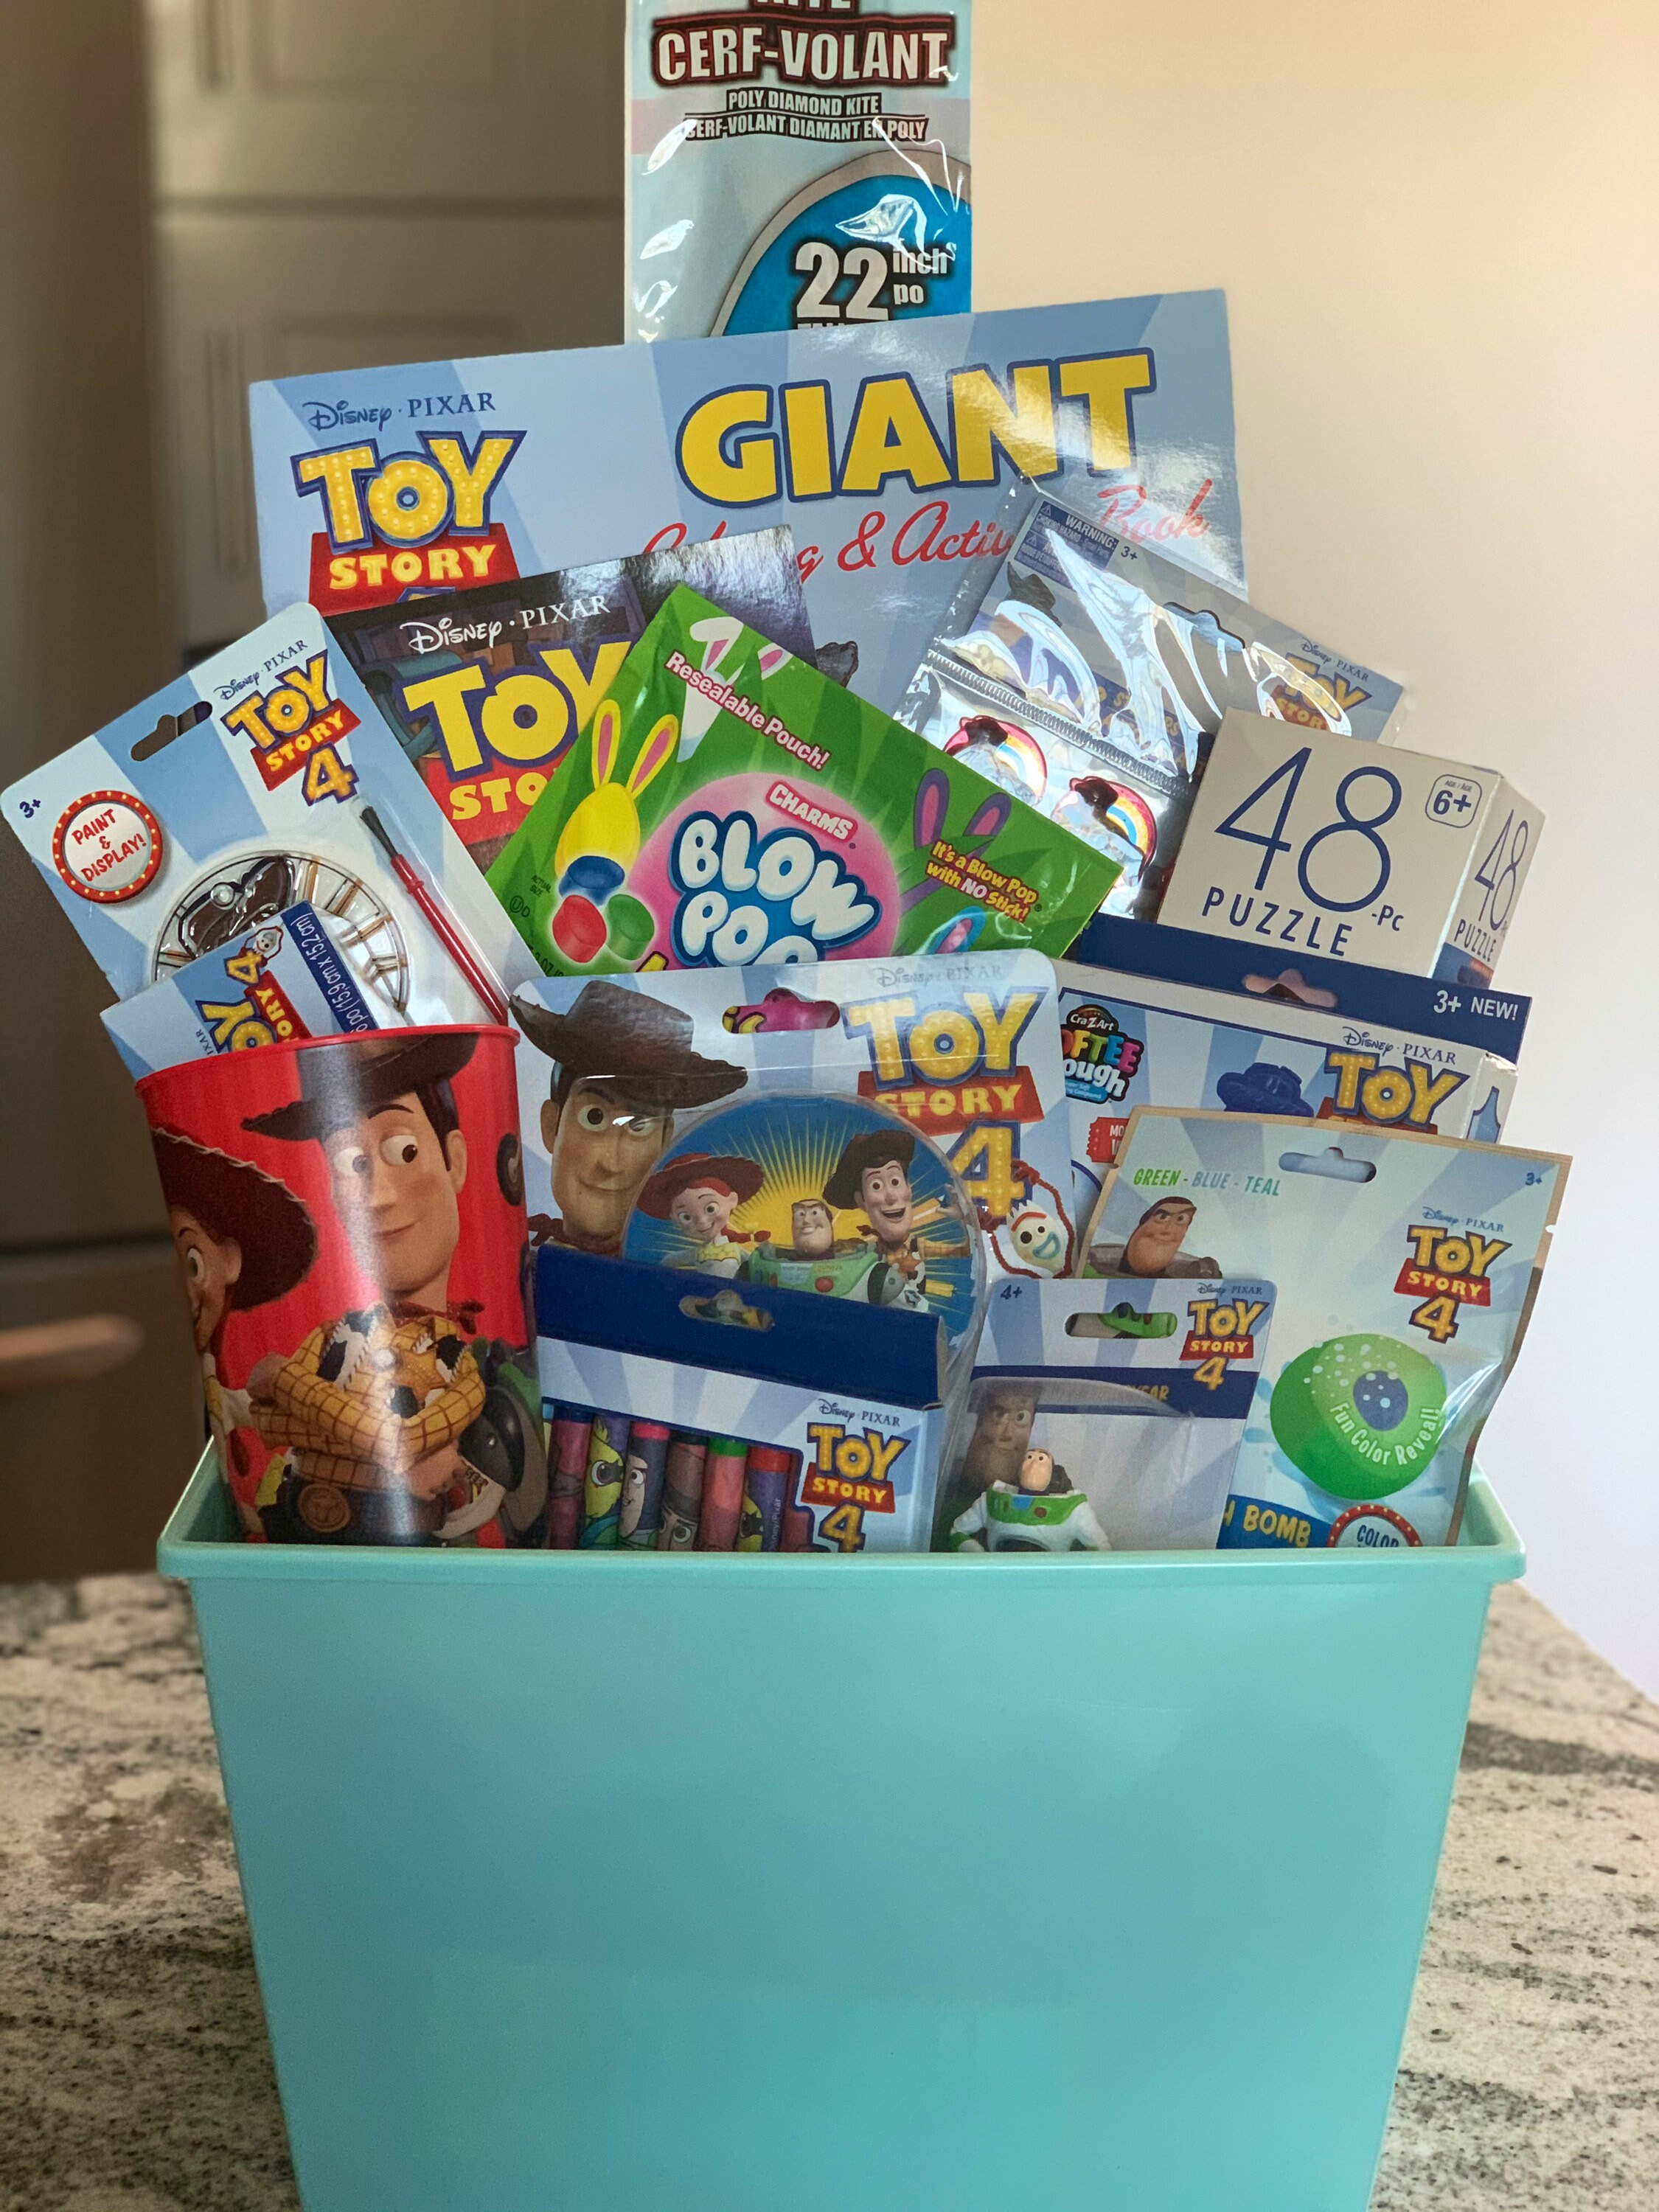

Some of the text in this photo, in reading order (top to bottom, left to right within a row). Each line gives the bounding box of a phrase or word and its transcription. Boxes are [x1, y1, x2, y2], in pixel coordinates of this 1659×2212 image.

[658, 27, 948, 82] CERF-VOLANT
[728, 91, 879, 116] POLY DIAMOND KITE
[790, 118, 860, 140] DIAMANT
[888, 119, 925, 140] POLY
[796, 241, 888, 321] 22
[893, 284, 925, 305] po
[408, 392, 496, 418] PIXAR
[676, 348, 1156, 508] GIANT
[291, 431, 527, 554] TOY
[838, 511, 886, 571] &
[891, 500, 1016, 567] Activ
[1065, 515, 1117, 551] WARNING:
[329, 544, 496, 590] STORY
[1120, 546, 1138, 561] 3+
[519, 596, 611, 629] PIXAR
[263, 639, 308, 672] PIXAR
[1336, 659, 1370, 683] PIXAR
[220, 650, 335, 755] TOY
[398, 640, 633, 774] TOY
[666, 651, 831, 771] Resealable Pouch!
[1277, 698, 1324, 730] STOR
[265, 710, 345, 773] STORY
[302, 742, 360, 807] 4
[19, 799, 41, 818] 3+
[449, 771, 549, 820] STO
[769, 783, 855, 841] CHARMS
[1433, 790, 1472, 815] 6+
[71, 808, 116, 846] PAINT
[99, 835, 111, 850] &
[1214, 746, 1402, 912] 48
[80, 835, 147, 883] DISPLAY!
[674, 814, 878, 944] BLOW
[932, 841, 1038, 905] It's a Blow Pop
[1475, 809, 1528, 932] 48
[529, 884, 543, 897] SIZE
[531, 874, 552, 894] ACTUAL
[927, 862, 1031, 923] with NO Stick!
[1201, 886, 1352, 957] PUZZLE
[1454, 918, 1498, 963] PUZZLE
[301, 933, 327, 960] 15,2
[225, 950, 262, 987] 4
[322, 964, 341, 984] cm
[946, 965, 1003, 981] PIXAR
[195, 998, 279, 1052] OY
[255, 987, 295, 1035] ORY
[1433, 990, 1519, 1021] 3+ NEW!
[195, 1028, 213, 1057] IXAR
[841, 986, 1050, 1091] TOY
[1060, 1029, 1141, 1074] OFTEE
[1402, 1043, 1456, 1065] PIXAR
[1063, 1058, 1126, 1098] ough
[1325, 1049, 1471, 1128] TOY
[874, 1084, 1022, 1118] STORY
[946, 1120, 1033, 1220] 4
[1133, 1168, 1180, 1187] GREEN
[1192, 1171, 1228, 1190] BLUE
[1244, 1175, 1281, 1195] TEAL
[1525, 1172, 1543, 1187] 3+
[1465, 1217, 1504, 1233] PIXAR
[1406, 1225, 1512, 1280] TOY
[1000, 1284, 1023, 1301] 4+
[1231, 1285, 1263, 1295] PIXAR
[1407, 1270, 1482, 1298] STORY
[1188, 1298, 1270, 1339] TOY
[1410, 1295, 1461, 1344] 4
[1189, 1340, 1250, 1354] STORY
[1193, 1355, 1229, 1391] 4
[860, 1411, 901, 1427] PIXAR
[1329, 1402, 1440, 1466] Fun Color Reveal!
[807, 1422, 911, 1483] TOY
[813, 1476, 887, 1504] STORY
[818, 1503, 866, 1552] 4
[1242, 1504, 1312, 1548] BOMB
